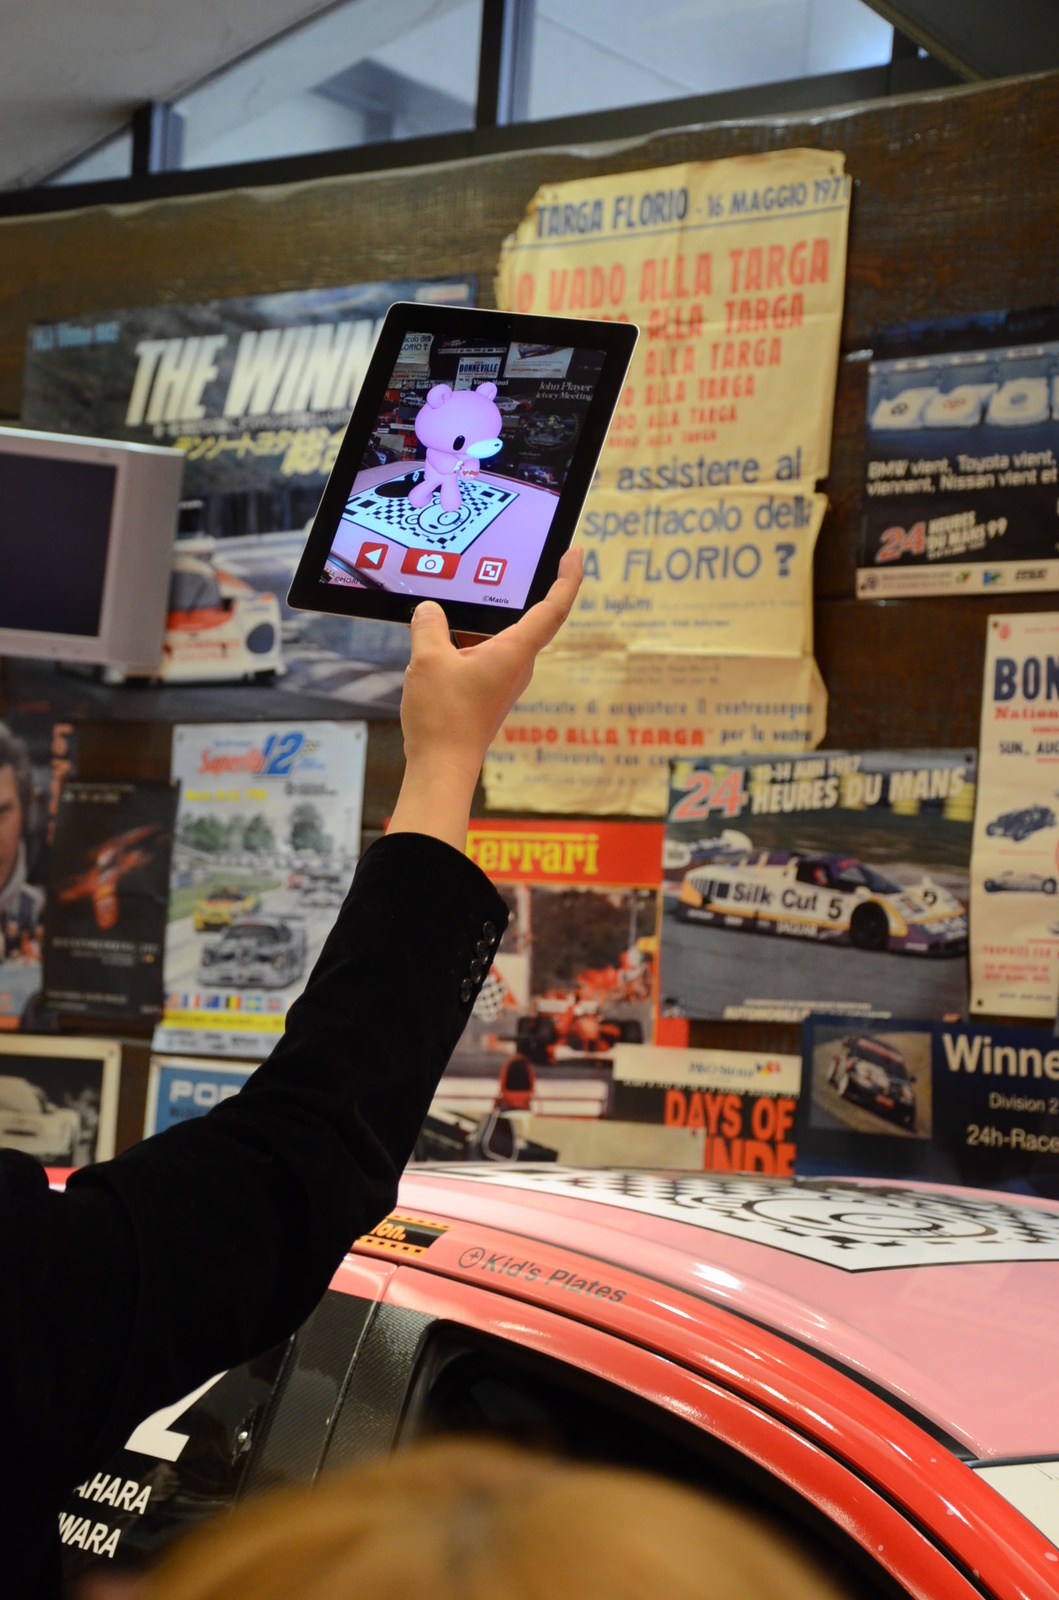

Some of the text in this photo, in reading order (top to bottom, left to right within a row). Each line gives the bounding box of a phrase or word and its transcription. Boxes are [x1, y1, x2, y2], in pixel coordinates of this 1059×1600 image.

[536, 198, 602, 238] TARGA
[612, 187, 689, 231] FLORIO
[729, 181, 808, 215] MAGGIO
[548, 263, 627, 312] VADO
[638, 252, 713, 304] ALLA
[729, 238, 829, 294] TARGA
[646, 293, 805, 343] ALLA TARGA
[459, 363, 498, 372] BONNEVILLE
[645, 337, 782, 378] ALLA TARGA
[126, 334, 228, 428] THE
[539, 381, 593, 392] John Player
[698, 374, 755, 401] TARGA
[617, 456, 759, 492] assistere
[777, 446, 801, 482] al
[866, 467, 1058, 497] viennent, Nissan vient et
[868, 449, 1057, 480] BMW vient, Toyota vient,
[582, 498, 742, 542] spettacolo
[987, 516, 1009, 539] 99
[623, 543, 762, 583] FLORIO
[775, 543, 797, 579] ?
[875, 521, 927, 563] 24
[262, 731, 305, 775] 12
[504, 726, 558, 744] VADO
[566, 727, 618, 745] ALLA
[669, 766, 747, 823] 24
[752, 766, 967, 816] HEURES DU MANS
[733, 879, 843, 921] Silk Cut 5
[922, 889, 938, 908] 5
[942, 1033, 1059, 1081] Winne
[664, 1089, 796, 1142] DAYS OF
[988, 1092, 1046, 1114] Division
[966, 1124, 1059, 1154] 24h-Race
[481, 1251, 627, 1304] Kid's Plates
